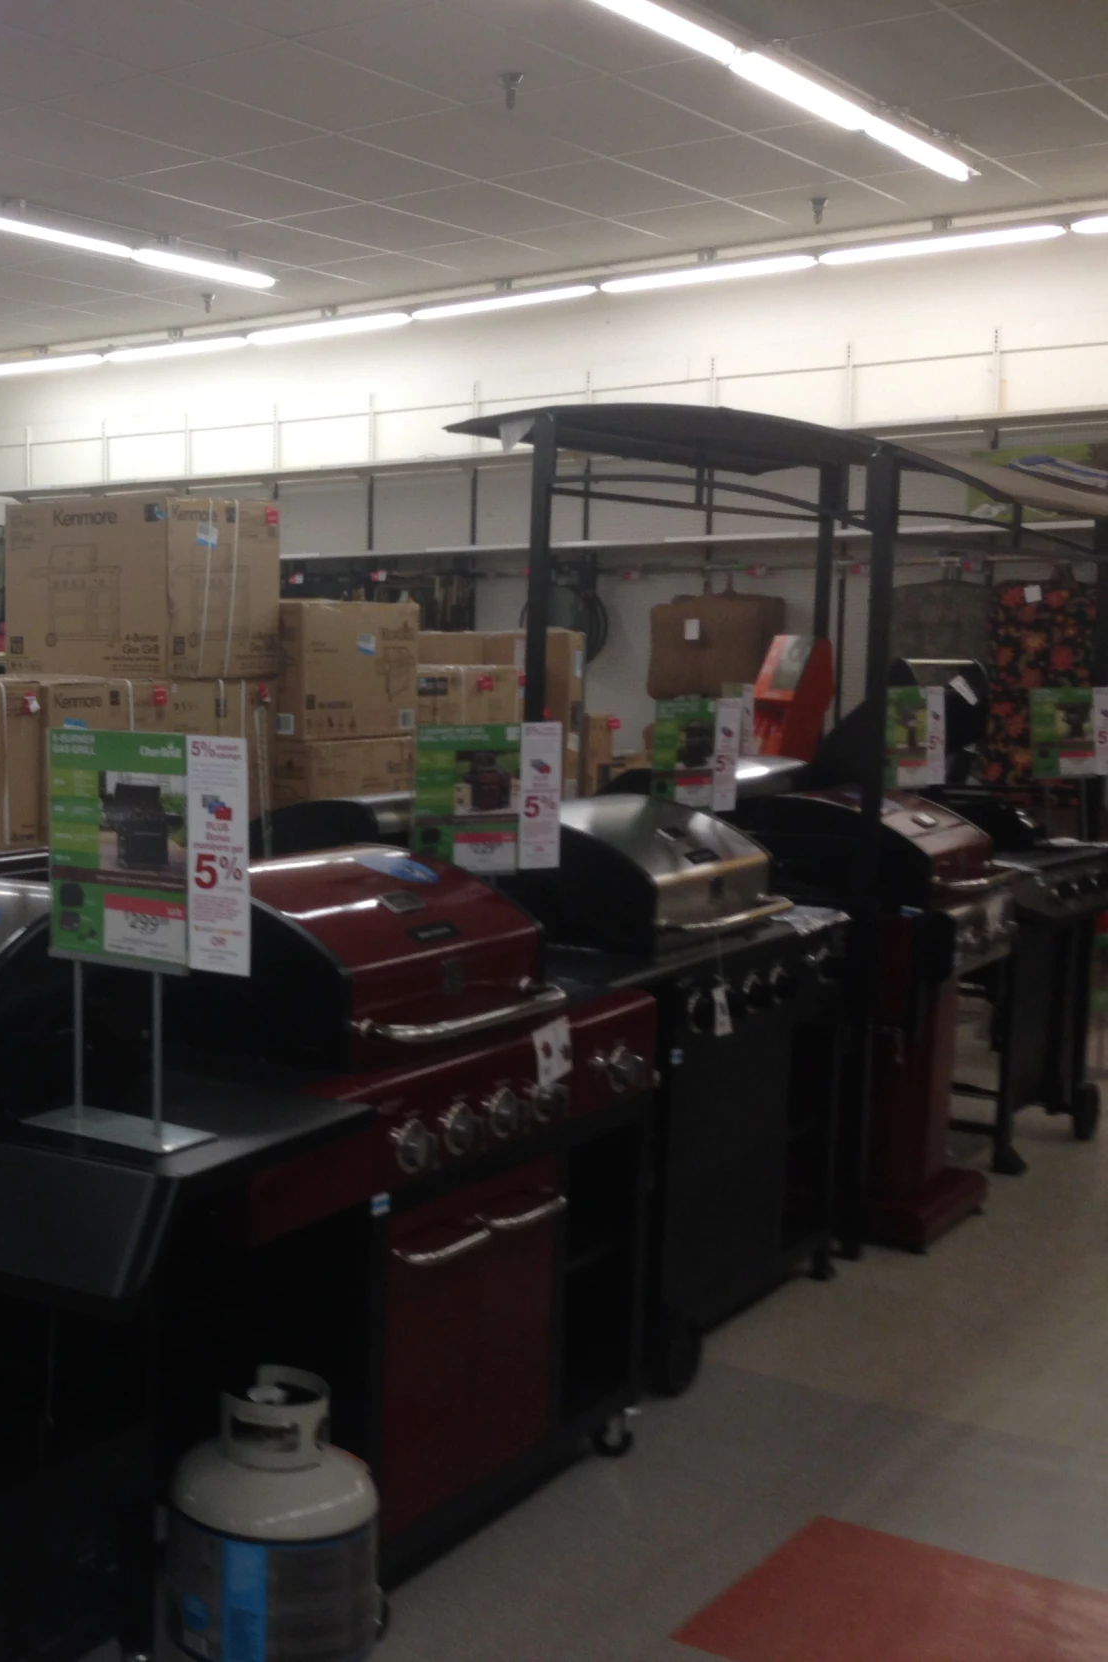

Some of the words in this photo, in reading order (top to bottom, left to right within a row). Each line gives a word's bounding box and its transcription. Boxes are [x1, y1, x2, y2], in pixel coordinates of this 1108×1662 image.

[52, 508, 118, 526] Kenmore
[53, 692, 103, 709] Kenmore
[194, 853, 242, 889] 5%
